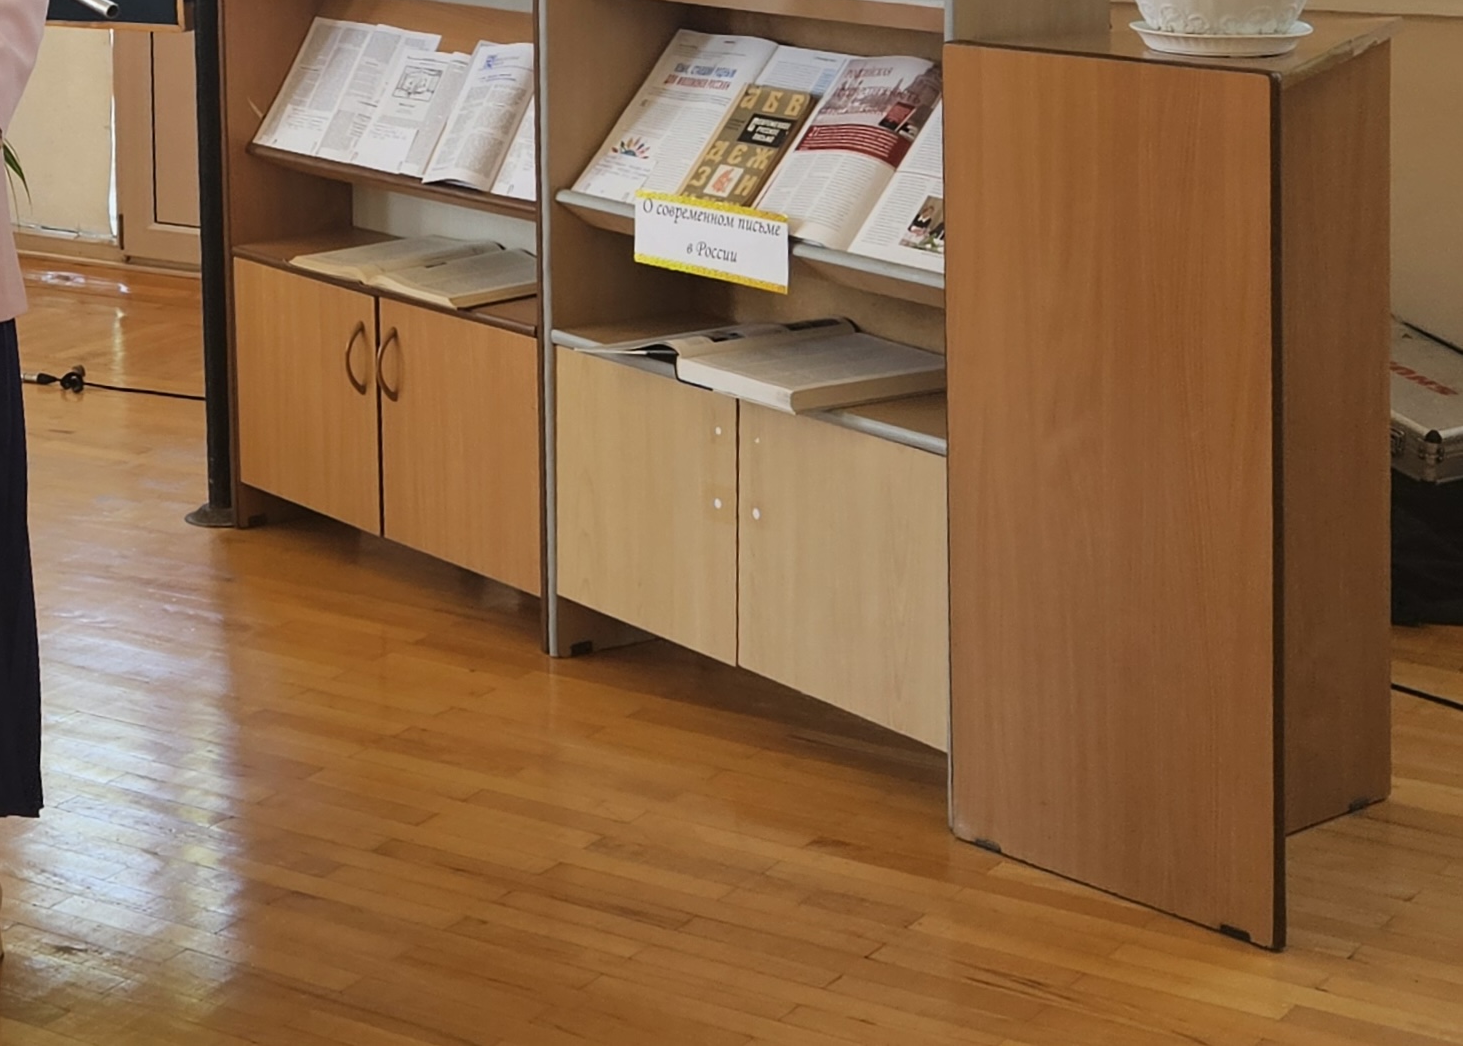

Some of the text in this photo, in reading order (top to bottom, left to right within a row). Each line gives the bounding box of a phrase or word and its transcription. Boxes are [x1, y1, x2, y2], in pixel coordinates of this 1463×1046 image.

[784, 93, 806, 117] В
[642, 197, 782, 237] О современном письме
[686, 240, 738, 263] в России
